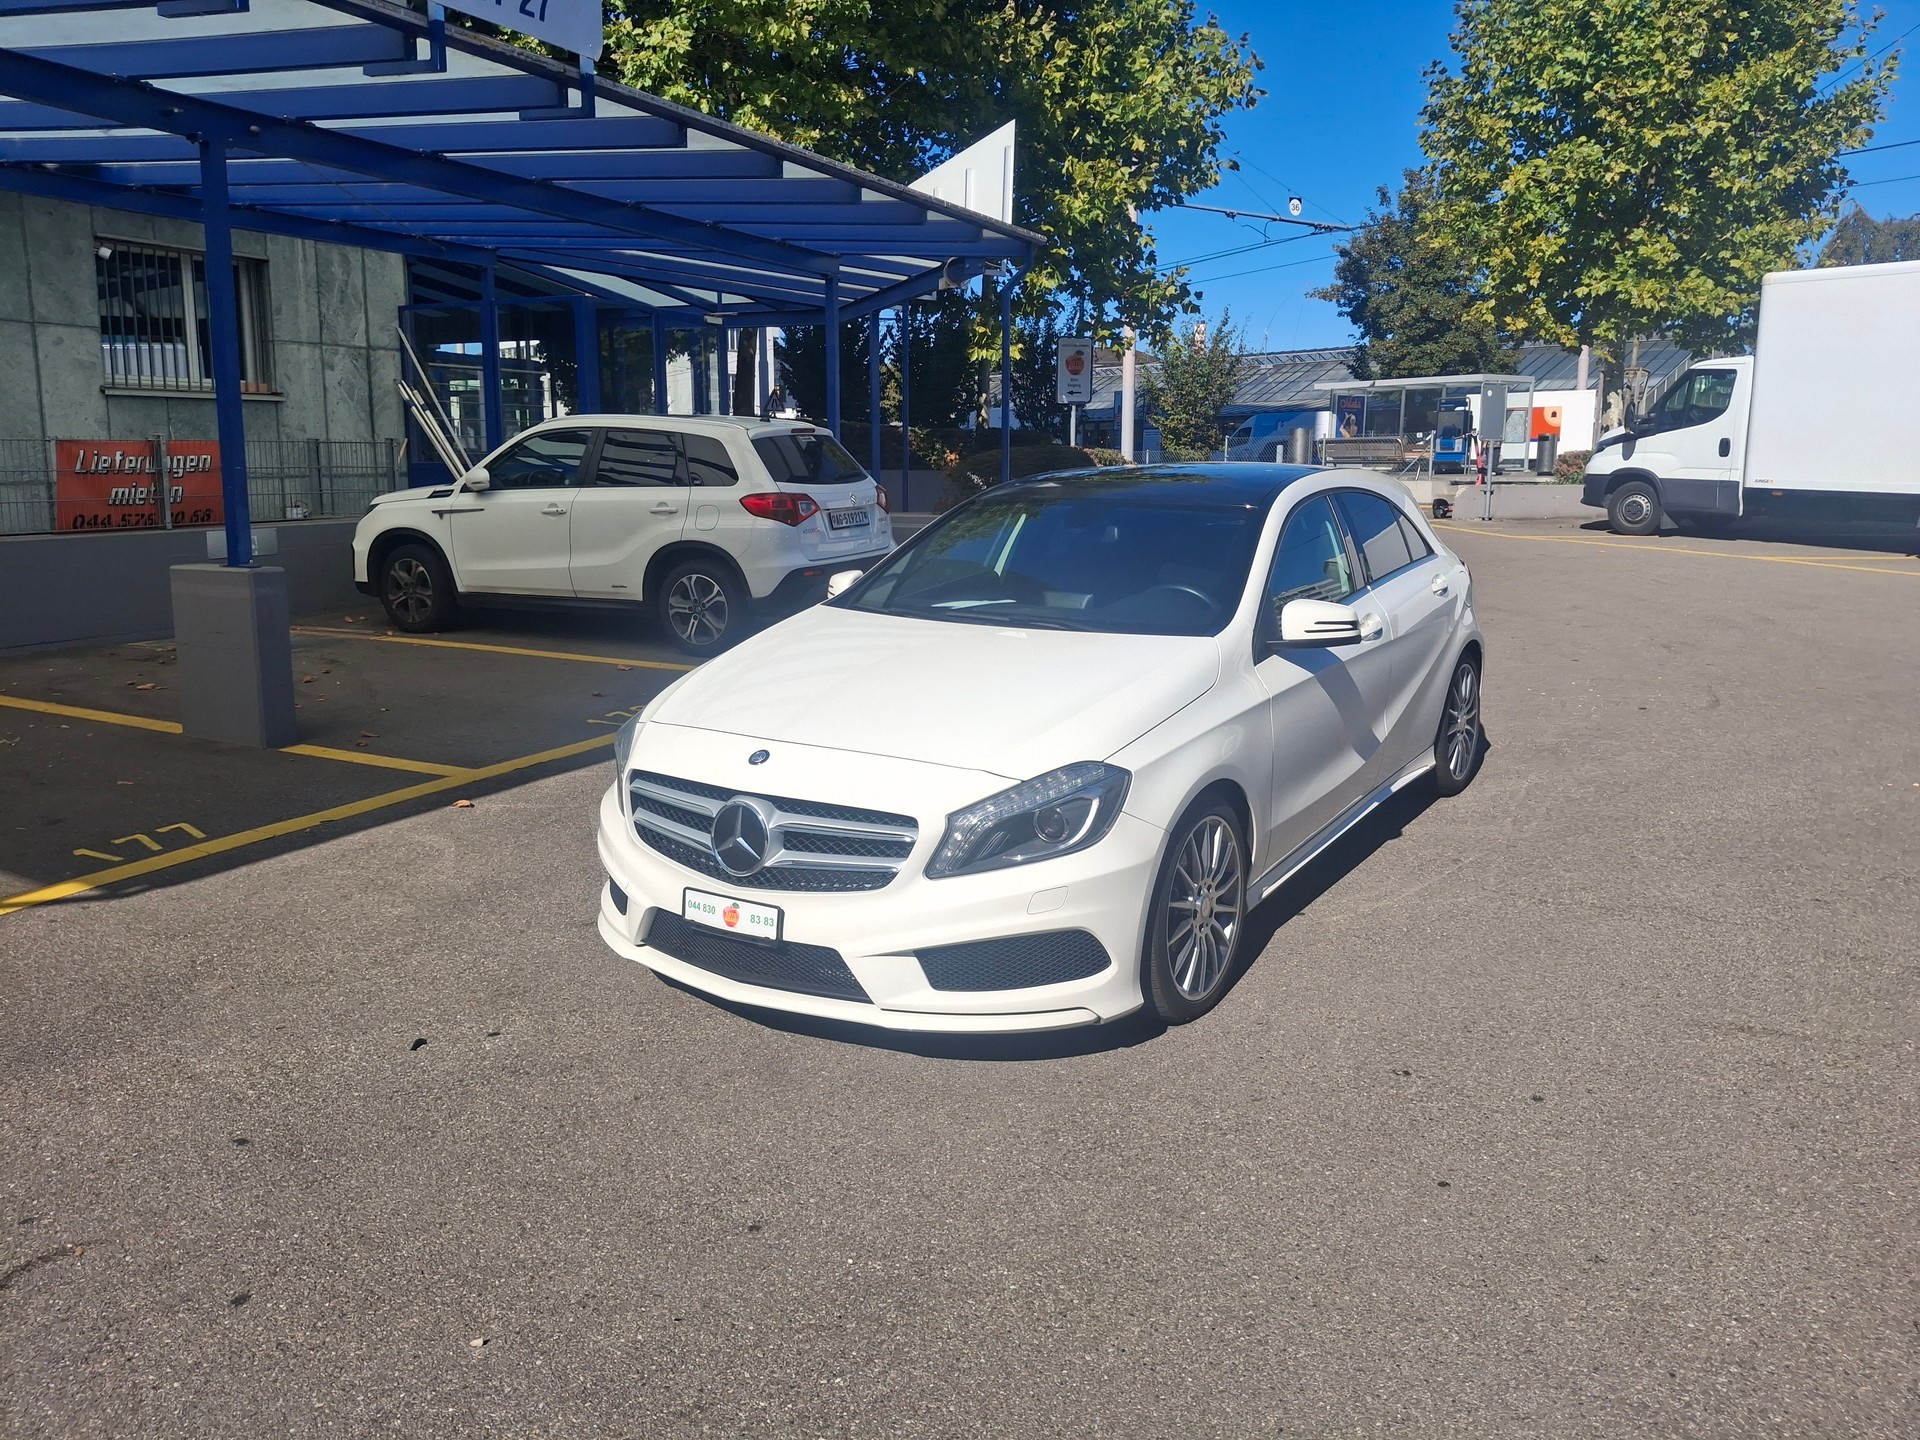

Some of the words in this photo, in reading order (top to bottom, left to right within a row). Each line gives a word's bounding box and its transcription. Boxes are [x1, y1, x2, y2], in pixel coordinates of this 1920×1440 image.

[1291, 203, 1300, 212] 36
[108, 482, 183, 505] mietn
[72, 822, 207, 862] 177
[688, 900, 701, 910] 044
[702, 904, 716, 915] 830
[750, 914, 761, 925] 83
[763, 916, 775, 927] 83
